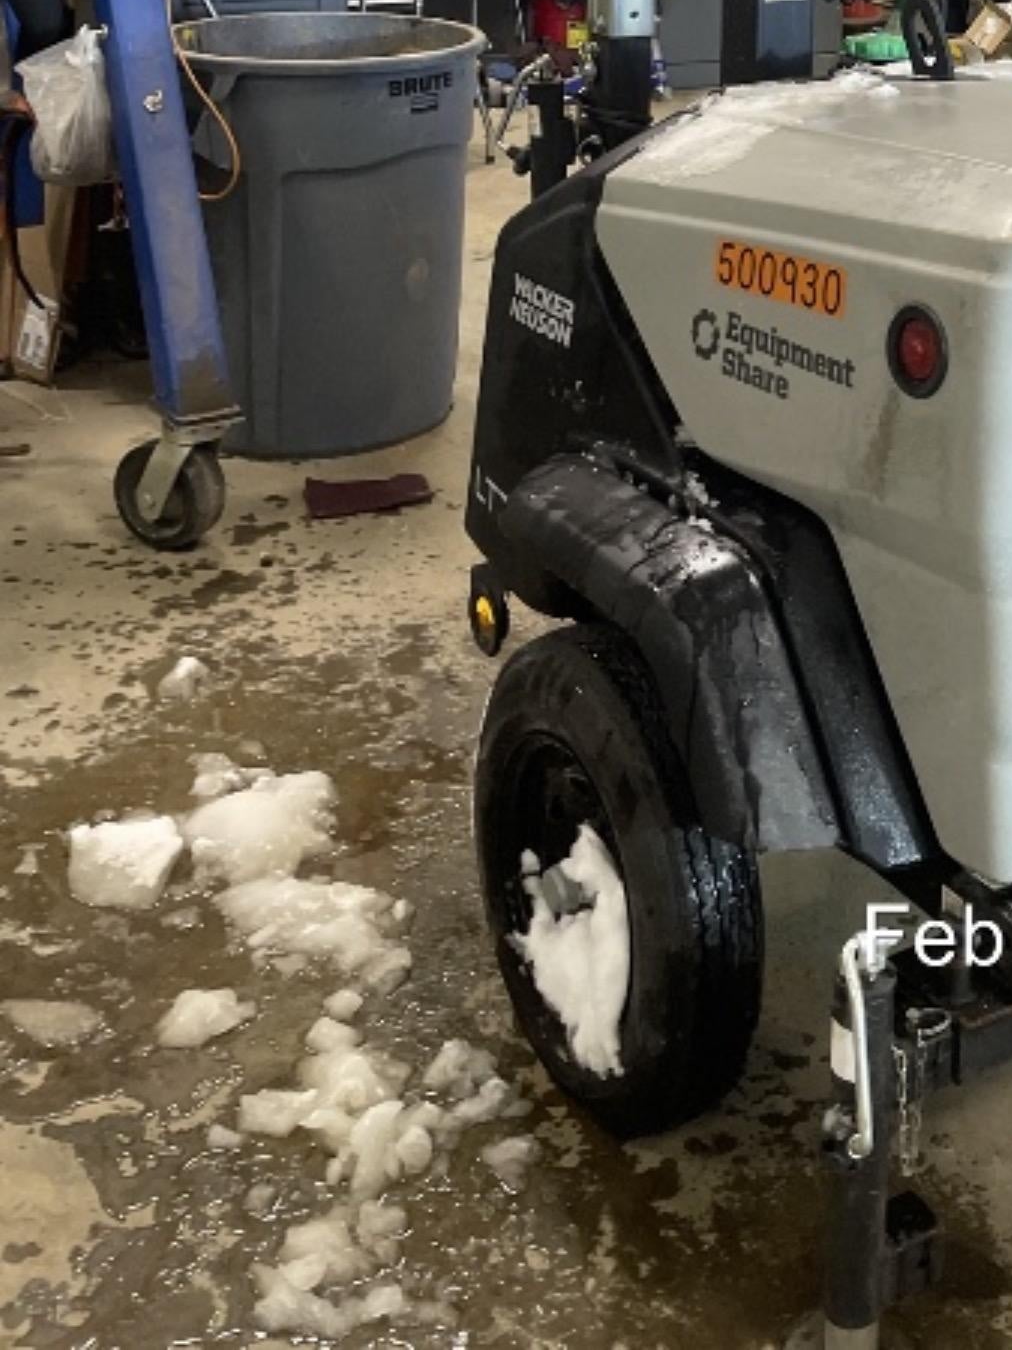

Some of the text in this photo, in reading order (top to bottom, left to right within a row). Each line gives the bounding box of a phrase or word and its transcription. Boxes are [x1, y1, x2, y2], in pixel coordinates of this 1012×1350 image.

[388, 71, 454, 98] BRUTE
[515, 272, 574, 326] WACKER
[718, 242, 842, 316] 500930
[509, 295, 573, 349] NEUSON
[721, 347, 790, 400] Share
[725, 311, 856, 389] Equipment
